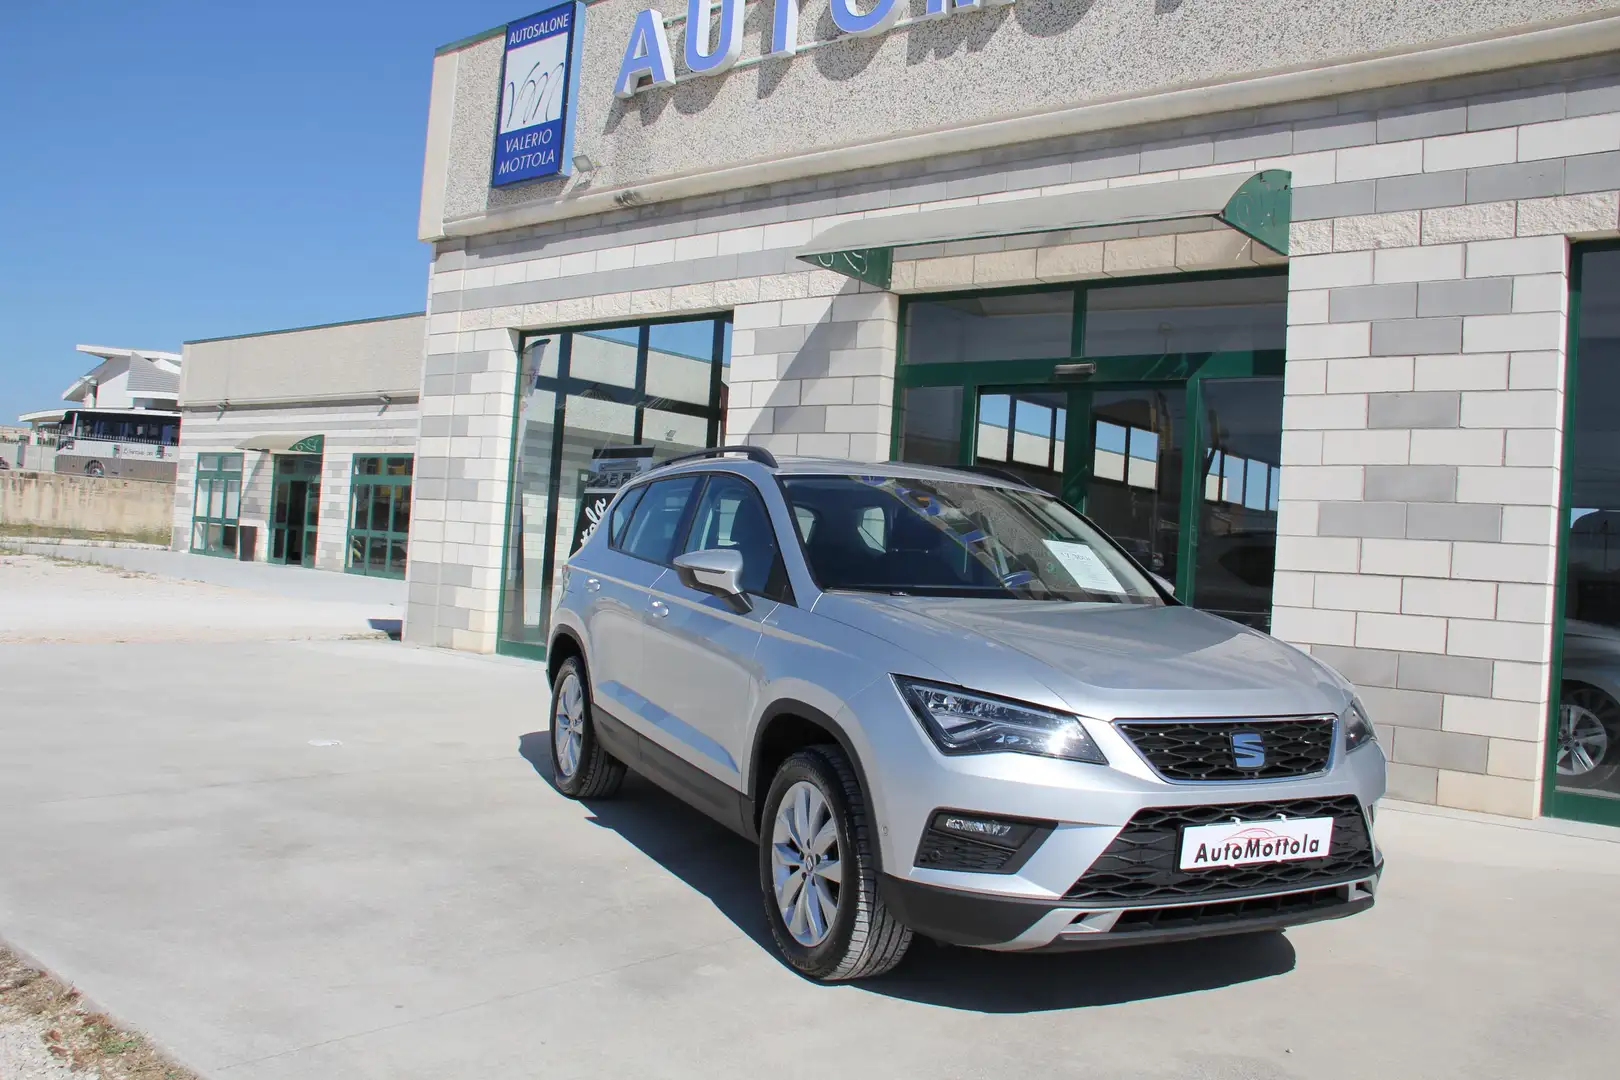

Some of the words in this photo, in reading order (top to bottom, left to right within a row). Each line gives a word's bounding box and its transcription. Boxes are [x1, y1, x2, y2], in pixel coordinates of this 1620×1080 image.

[509, 13, 570, 45] AUTOSALONE
[505, 128, 552, 153] VALERIO
[498, 149, 555, 175] MOTTOLA
[1194, 833, 1319, 863] AutoMottola
